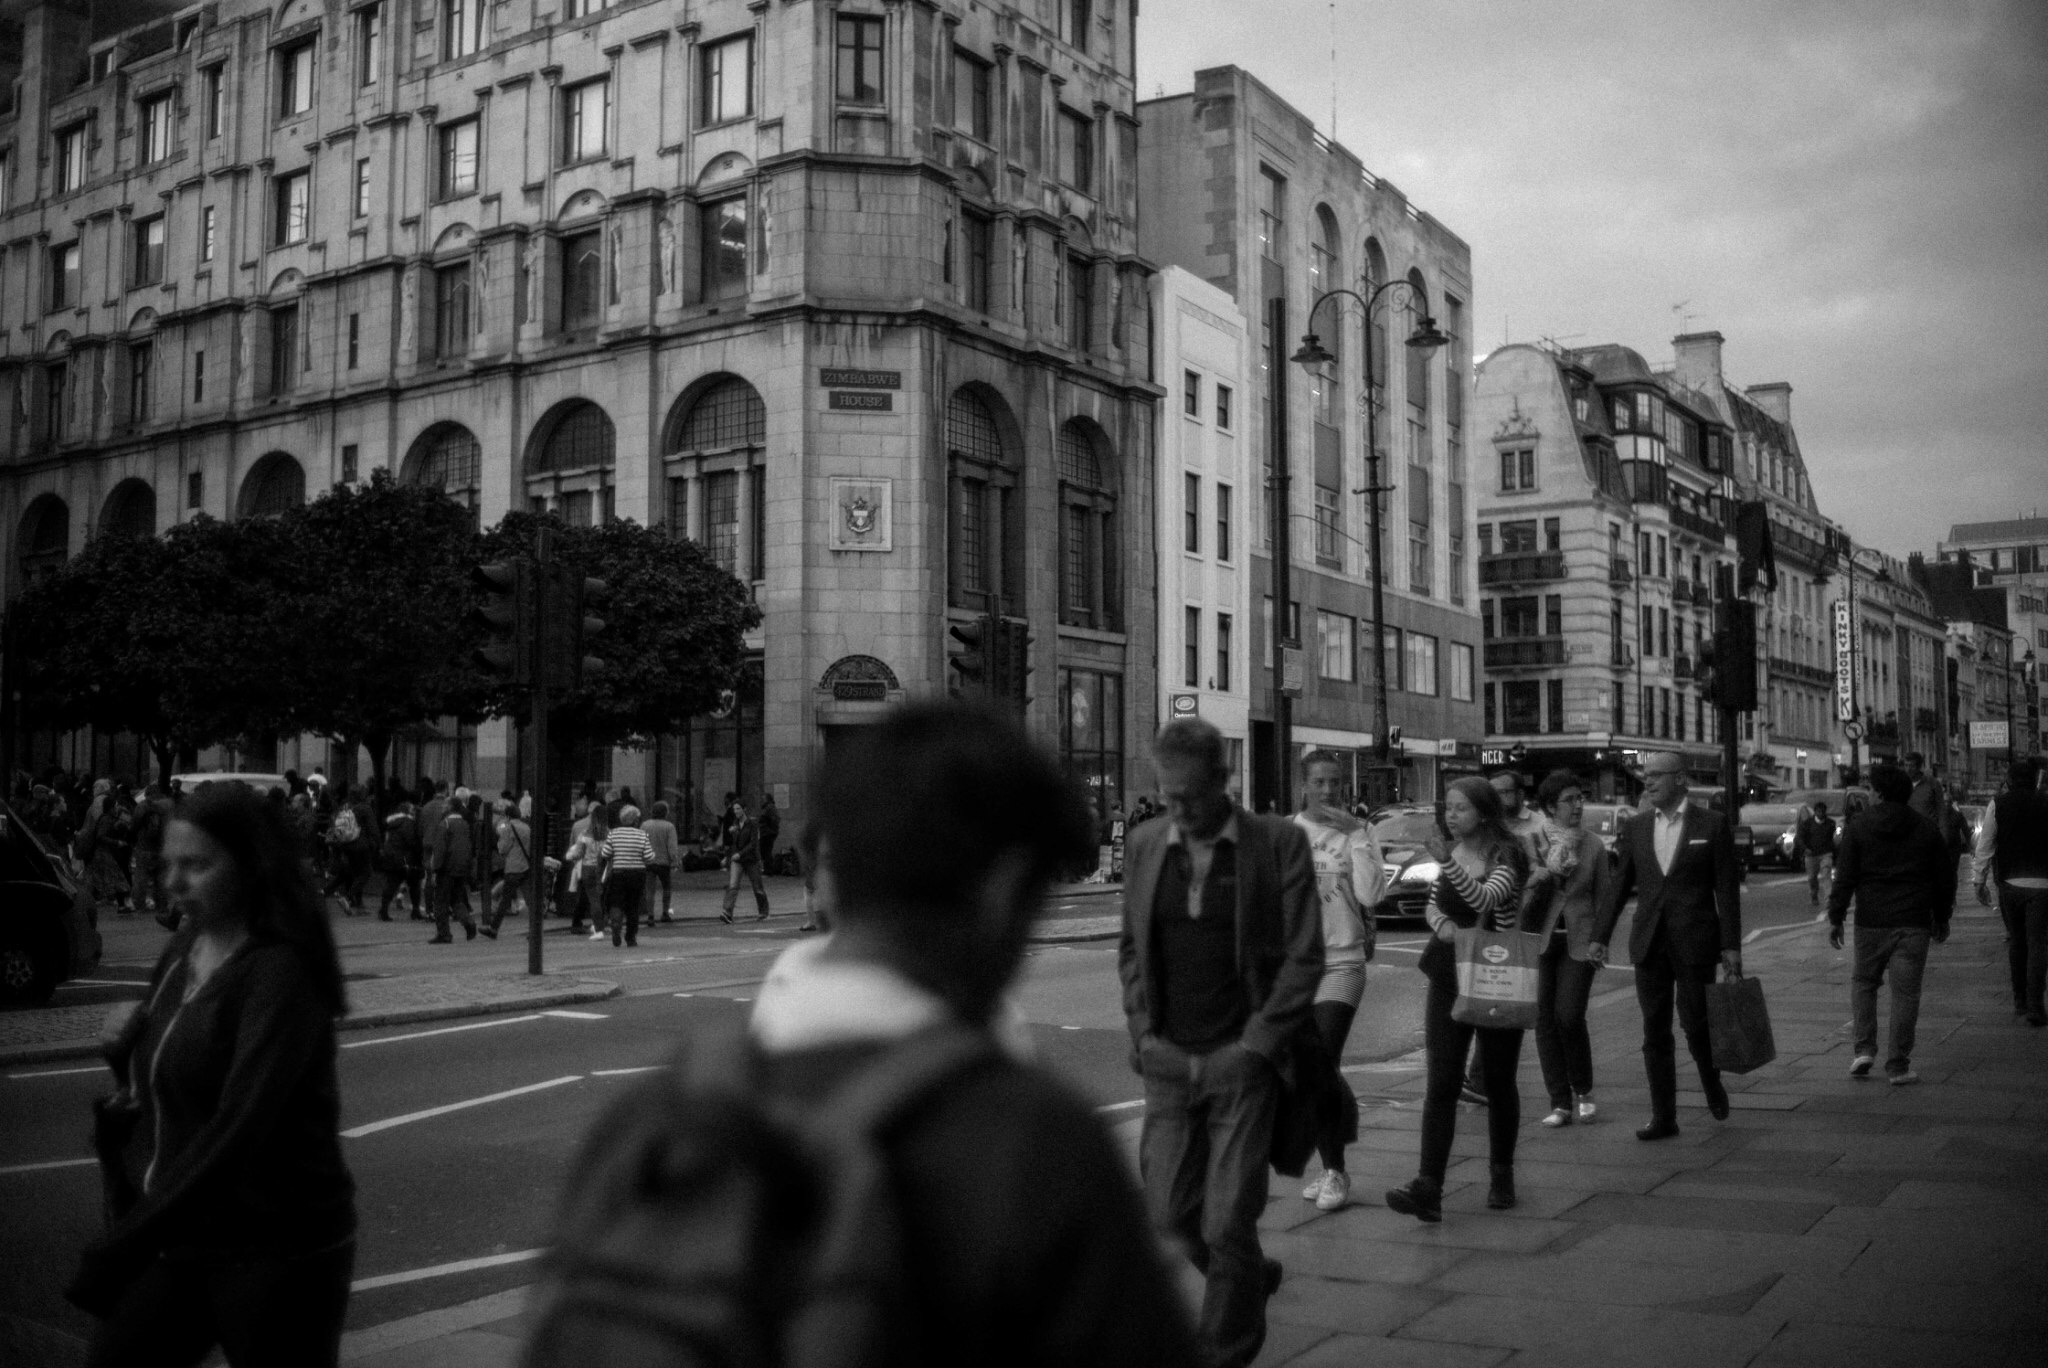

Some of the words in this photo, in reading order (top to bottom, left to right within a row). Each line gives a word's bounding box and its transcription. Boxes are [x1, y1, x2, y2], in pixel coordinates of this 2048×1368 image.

[824, 373, 898, 386] ZIMBABWE
[839, 395, 883, 407] HOUSE
[1837, 604, 1848, 648] KINKY
[1839, 651, 1849, 694] BOOTS
[853, 686, 885, 697] STRAND
[1482, 750, 1504, 765] NGER
